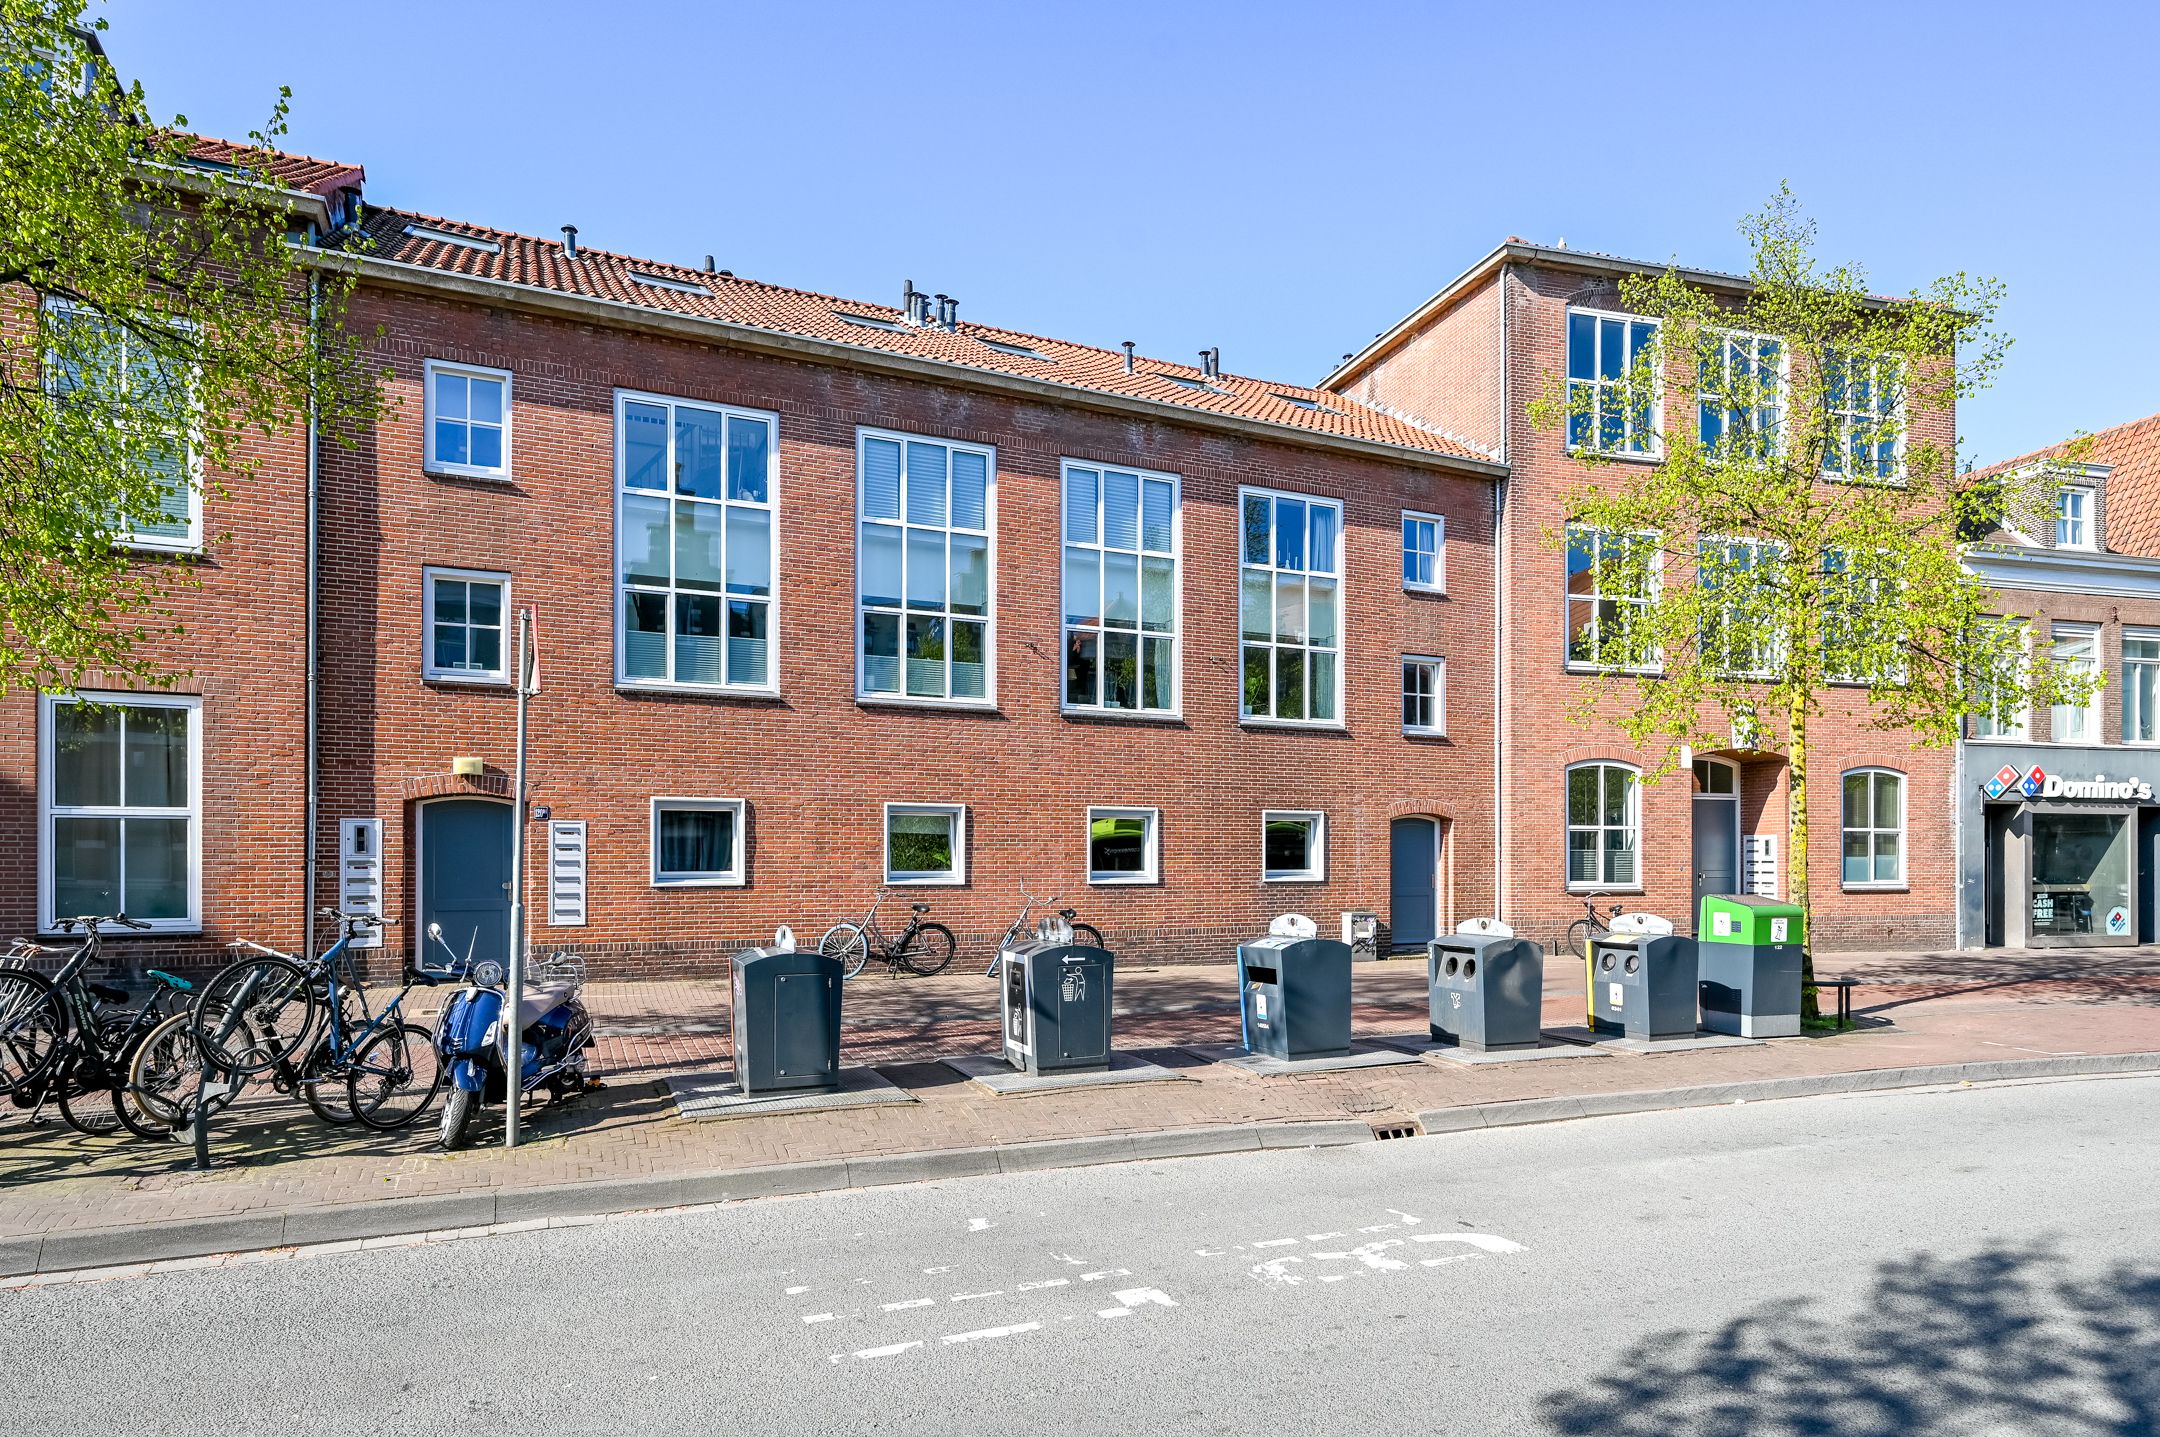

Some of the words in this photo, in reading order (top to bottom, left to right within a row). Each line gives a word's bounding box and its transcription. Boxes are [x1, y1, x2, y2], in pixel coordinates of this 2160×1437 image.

[2042, 774, 2152, 799] Domino's
[2033, 899, 2053, 908] CASH
[2033, 908, 2053, 918] FREE
[74, 993, 89, 1030] BATAVUS
